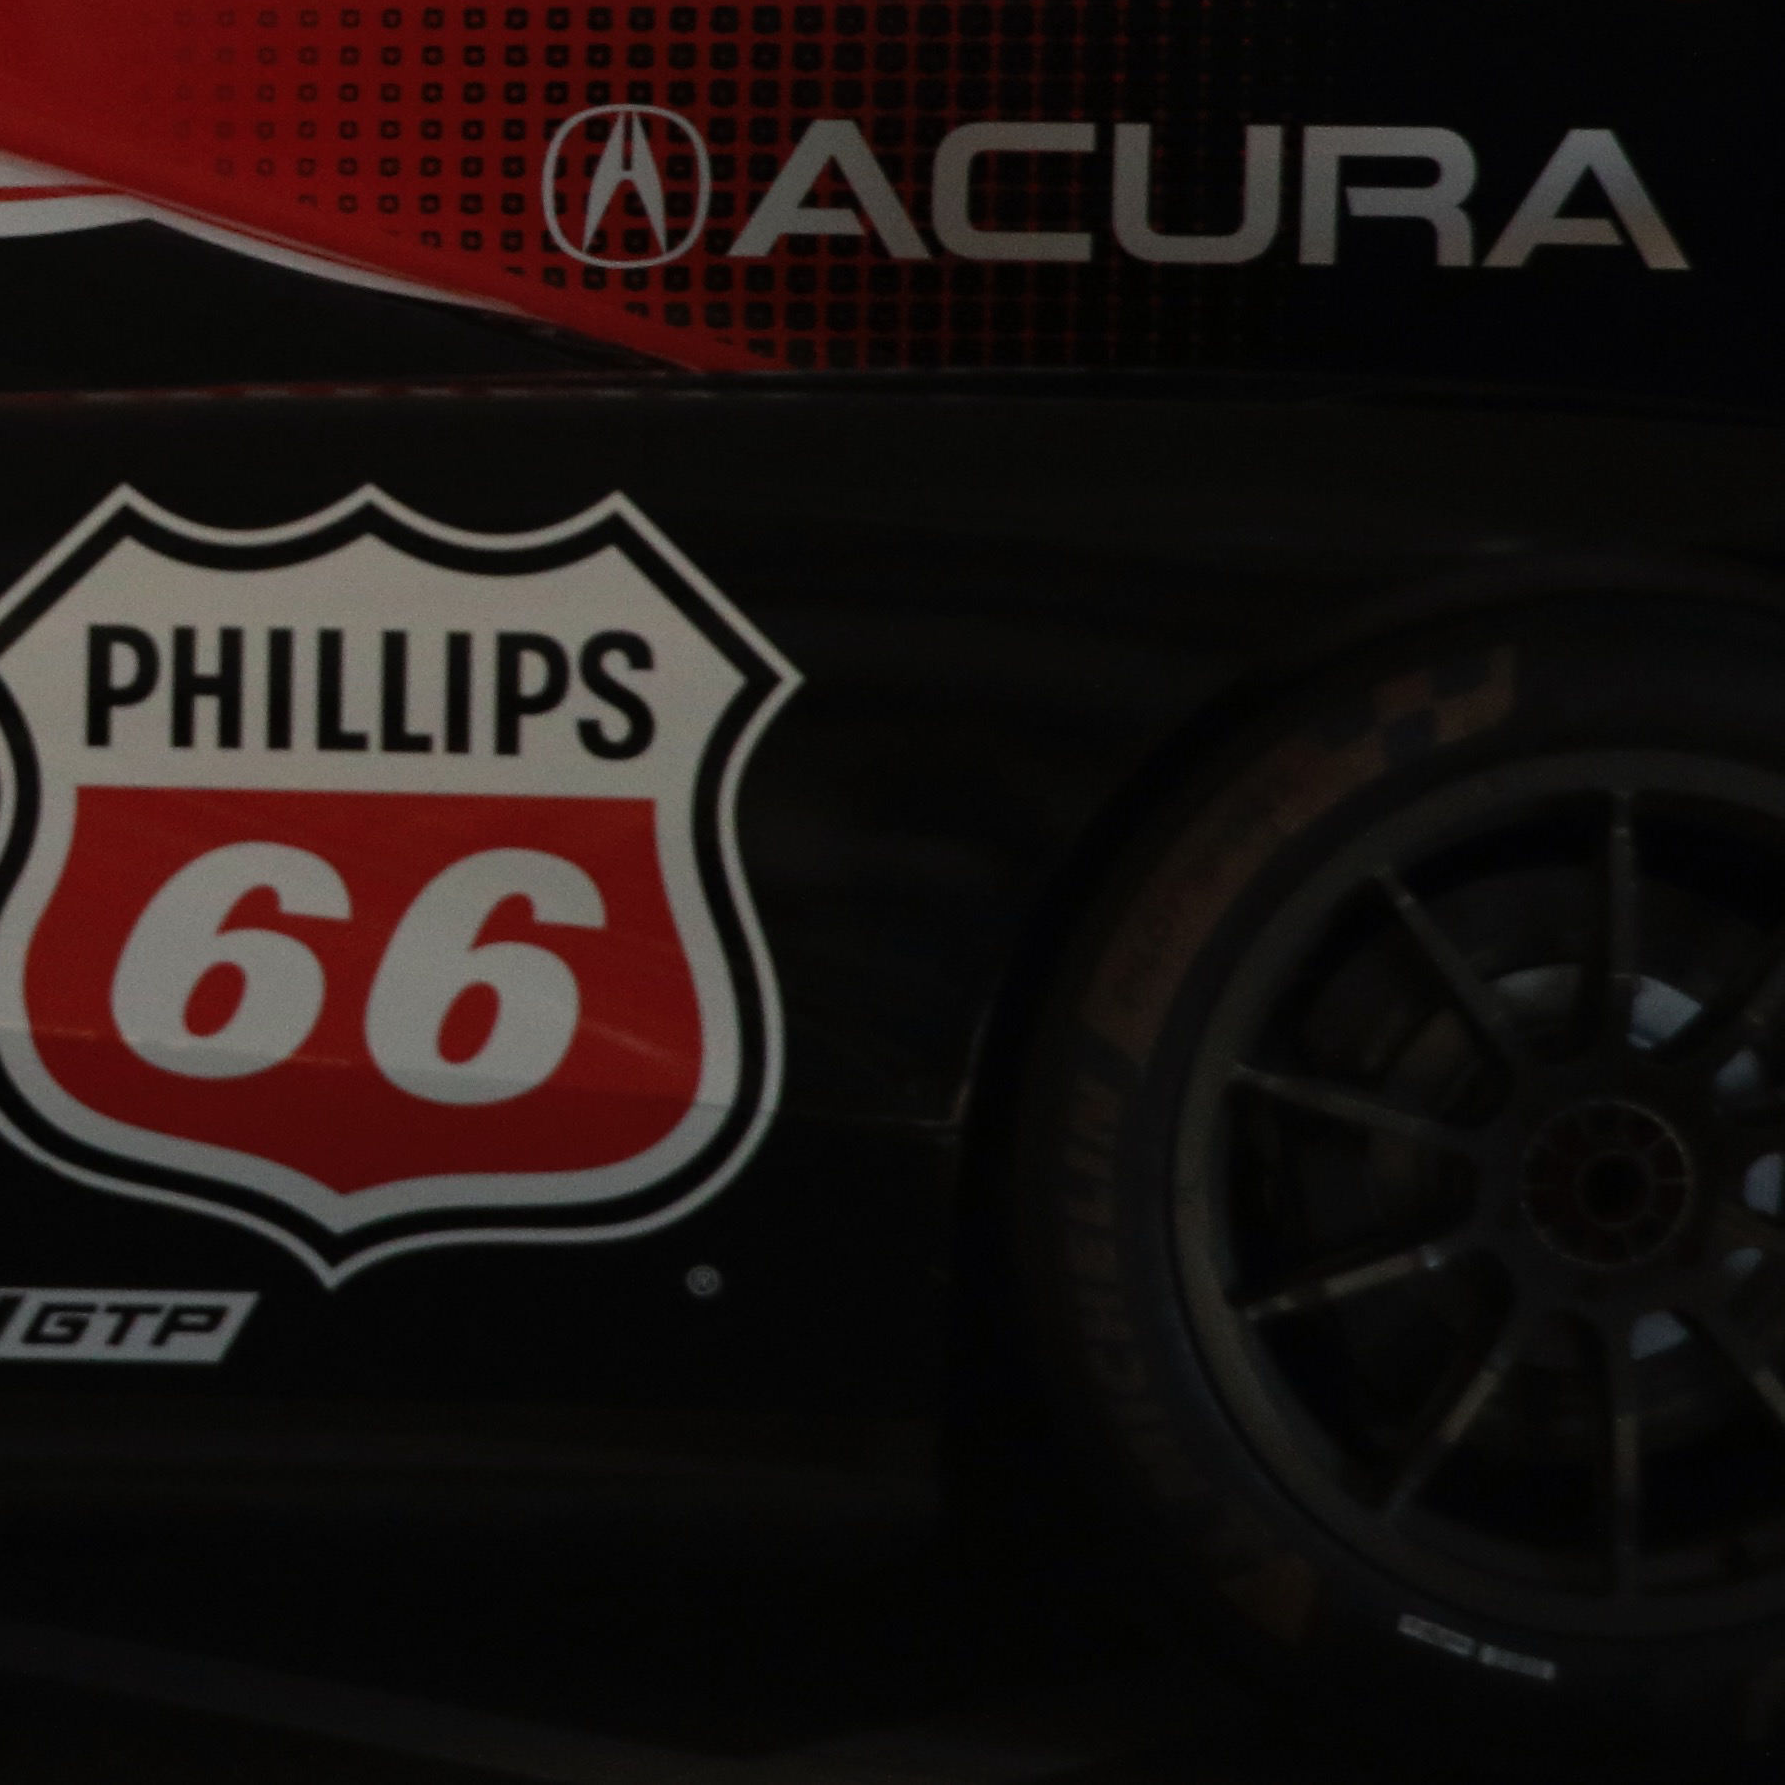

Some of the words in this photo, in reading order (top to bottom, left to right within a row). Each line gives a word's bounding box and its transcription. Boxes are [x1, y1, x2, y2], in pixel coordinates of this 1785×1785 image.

[727, 117, 1692, 270] ACURA
[84, 622, 659, 762] PHILLIPS
[109, 840, 608, 1106] 66
[19, 1301, 230, 1349] GTP
